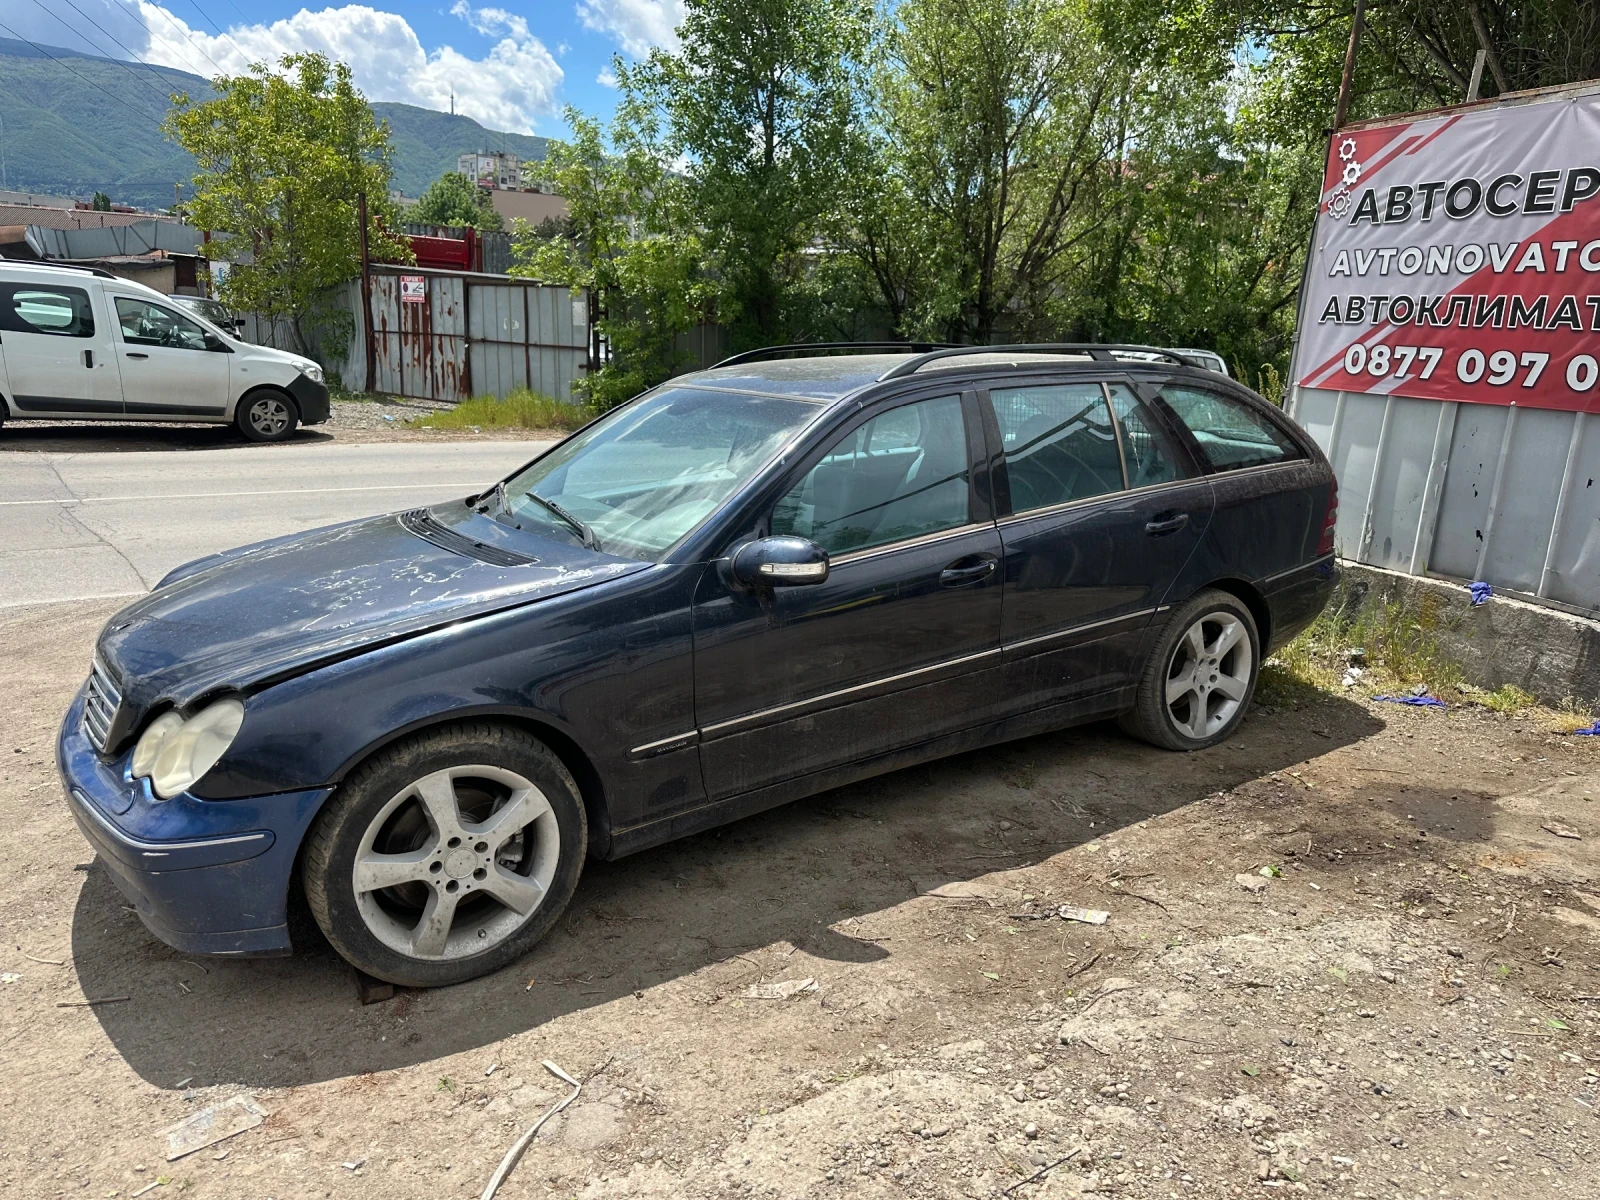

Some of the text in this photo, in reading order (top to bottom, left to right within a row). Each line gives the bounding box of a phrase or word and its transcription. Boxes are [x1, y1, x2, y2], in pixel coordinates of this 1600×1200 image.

[1348, 166, 1600, 226] АВТОСЕР
[1343, 343, 1444, 380] 0877
[1456, 348, 1550, 388] 097
